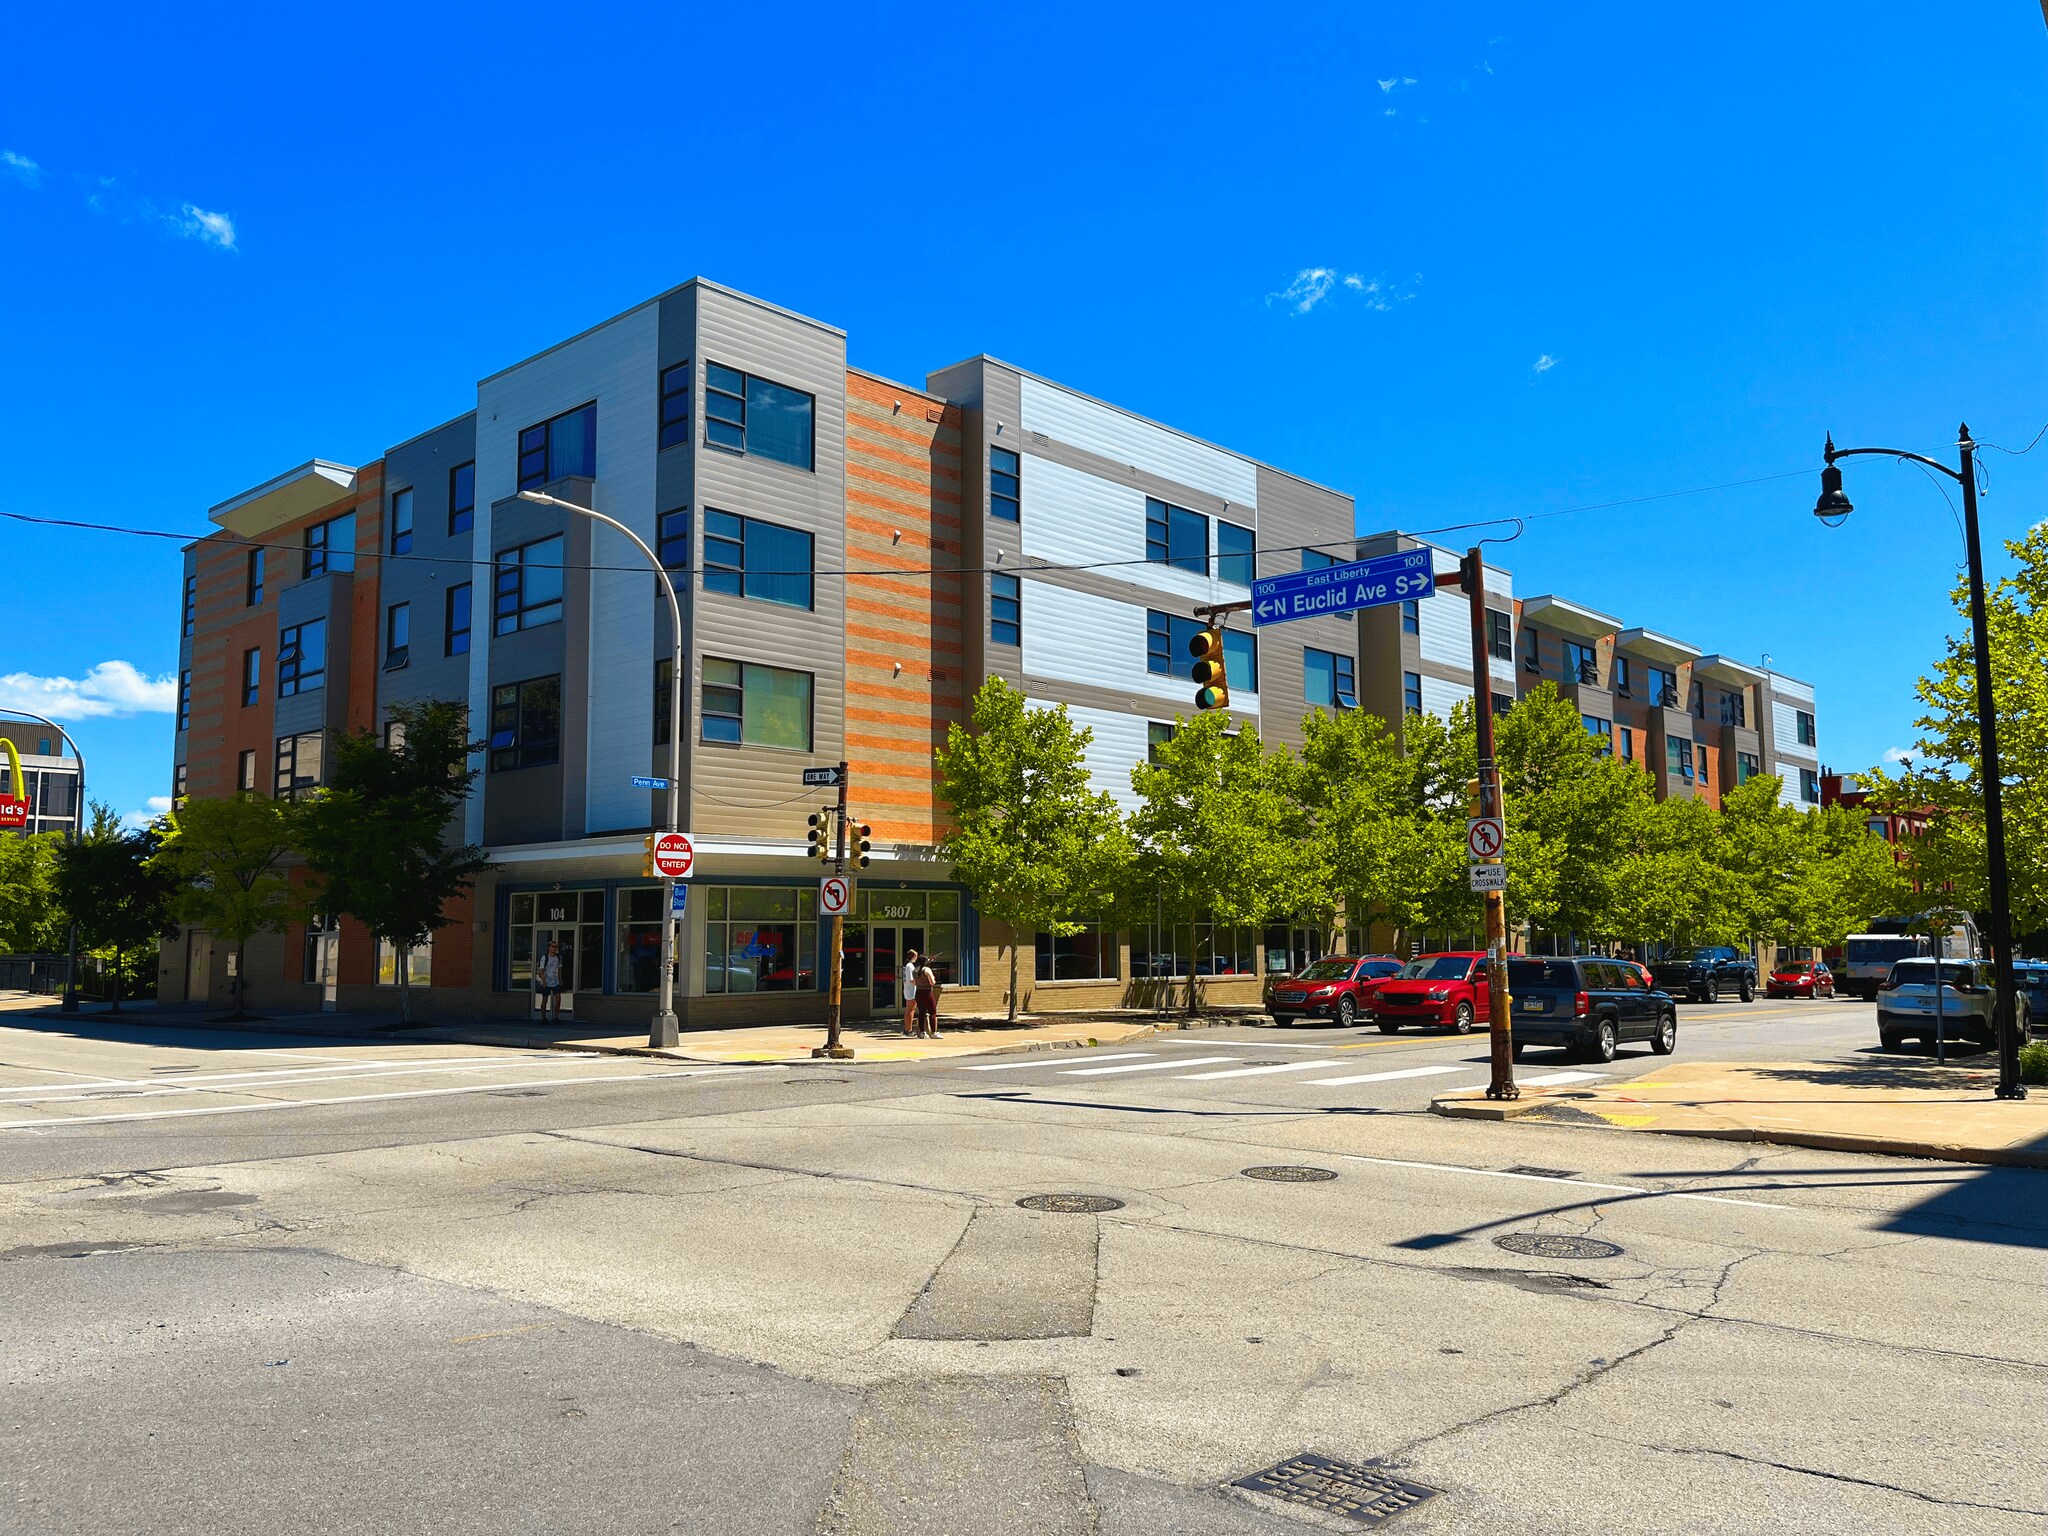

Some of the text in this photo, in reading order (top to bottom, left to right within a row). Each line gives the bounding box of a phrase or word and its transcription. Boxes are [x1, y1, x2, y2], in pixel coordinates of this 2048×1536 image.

[1404, 555, 1424, 567] 100
[1307, 567, 1370, 586] East Liberty
[1257, 583, 1276, 595] 100
[1274, 576, 1409, 617] N Euclid Ave S
[806, 771, 830, 781] ONE WAY
[633, 778, 665, 788] Penn Ave
[660, 841, 689, 851] DO NOT
[661, 861, 686, 869] ENTER
[1487, 868, 1501, 876] USE
[1472, 879, 1505, 887] CROSSWALK
[674, 887, 685, 896] Bus
[673, 897, 685, 907] Stop
[550, 907, 565, 920] 104
[884, 905, 911, 918] 5807
